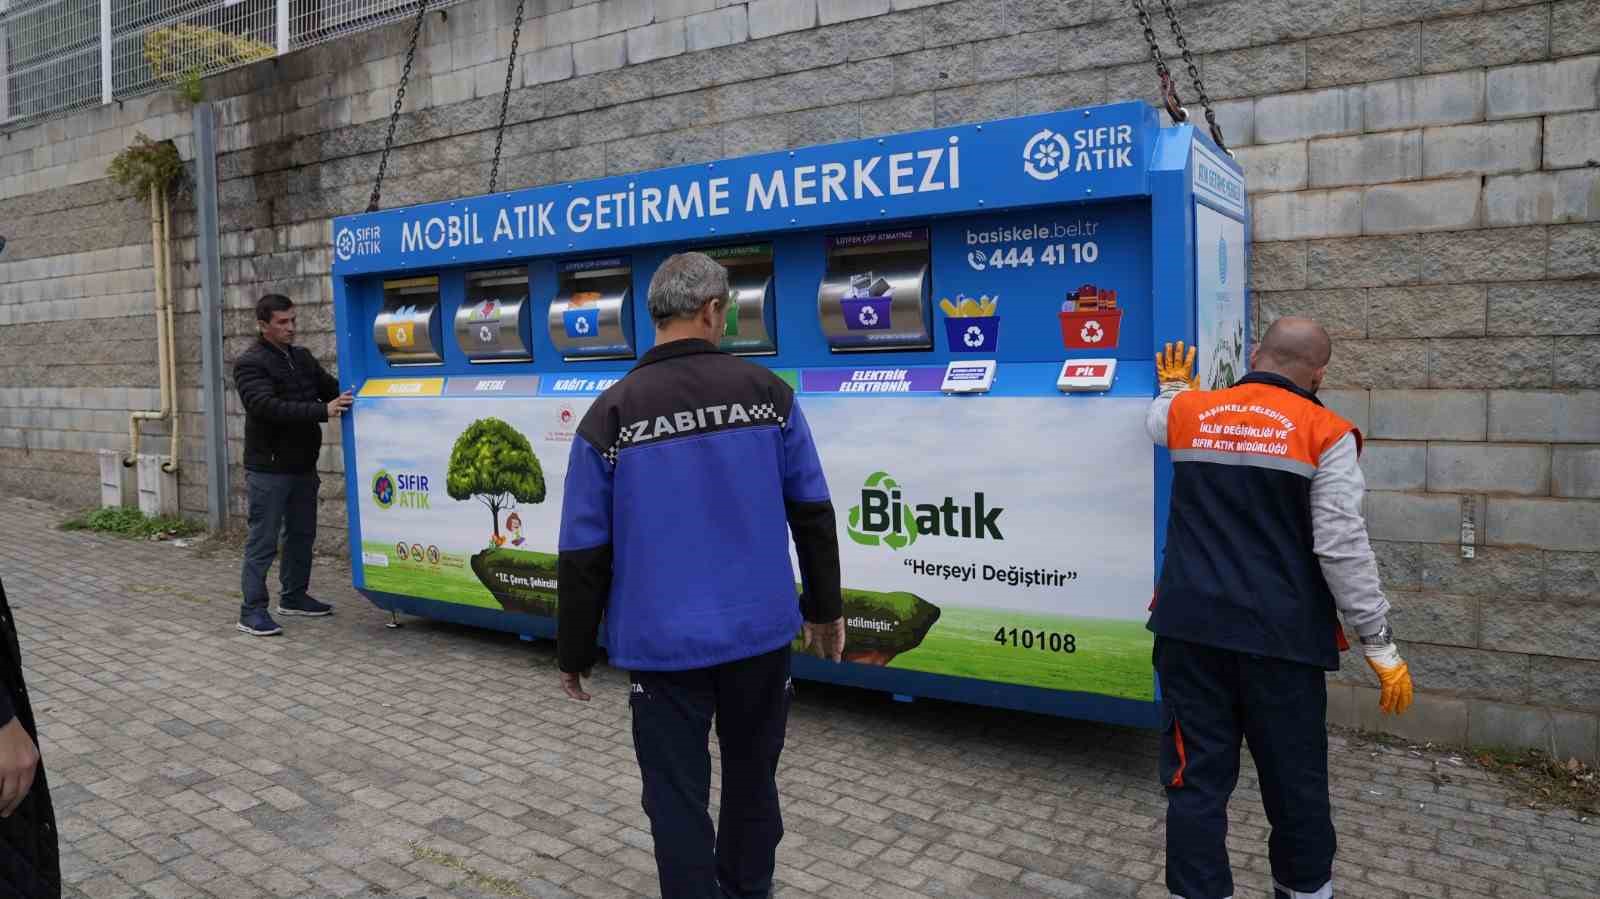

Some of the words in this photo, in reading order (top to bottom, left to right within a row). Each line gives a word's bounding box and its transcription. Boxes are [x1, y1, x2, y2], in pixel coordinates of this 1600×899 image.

[1073, 124, 1133, 150] SIFIR
[1074, 146, 1134, 173] ATIK
[401, 205, 484, 253] MOBİL
[493, 201, 556, 242] ATIK
[566, 176, 729, 233] GETİRME
[745, 135, 960, 212] MERKEZİ
[356, 225, 382, 242] SIFIR
[966, 219, 1099, 245] basiskele.bel.tr
[357, 241, 382, 256] ATIK
[989, 245, 1035, 269] 444
[1041, 244, 1066, 266] 41
[1071, 241, 1099, 263] 10
[852, 367, 908, 381] ELEKTRİK
[1075, 366, 1095, 377] PİL
[586, 380, 596, 391] &
[839, 379, 912, 393] ELEKTRONİK
[630, 403, 751, 443] ZABITA
[1276, 430, 1288, 440] VE
[1215, 439, 1236, 450] ATIK
[398, 474, 429, 492] SIFIR
[400, 490, 432, 509] ATIK
[994, 626, 1077, 654] 410108
